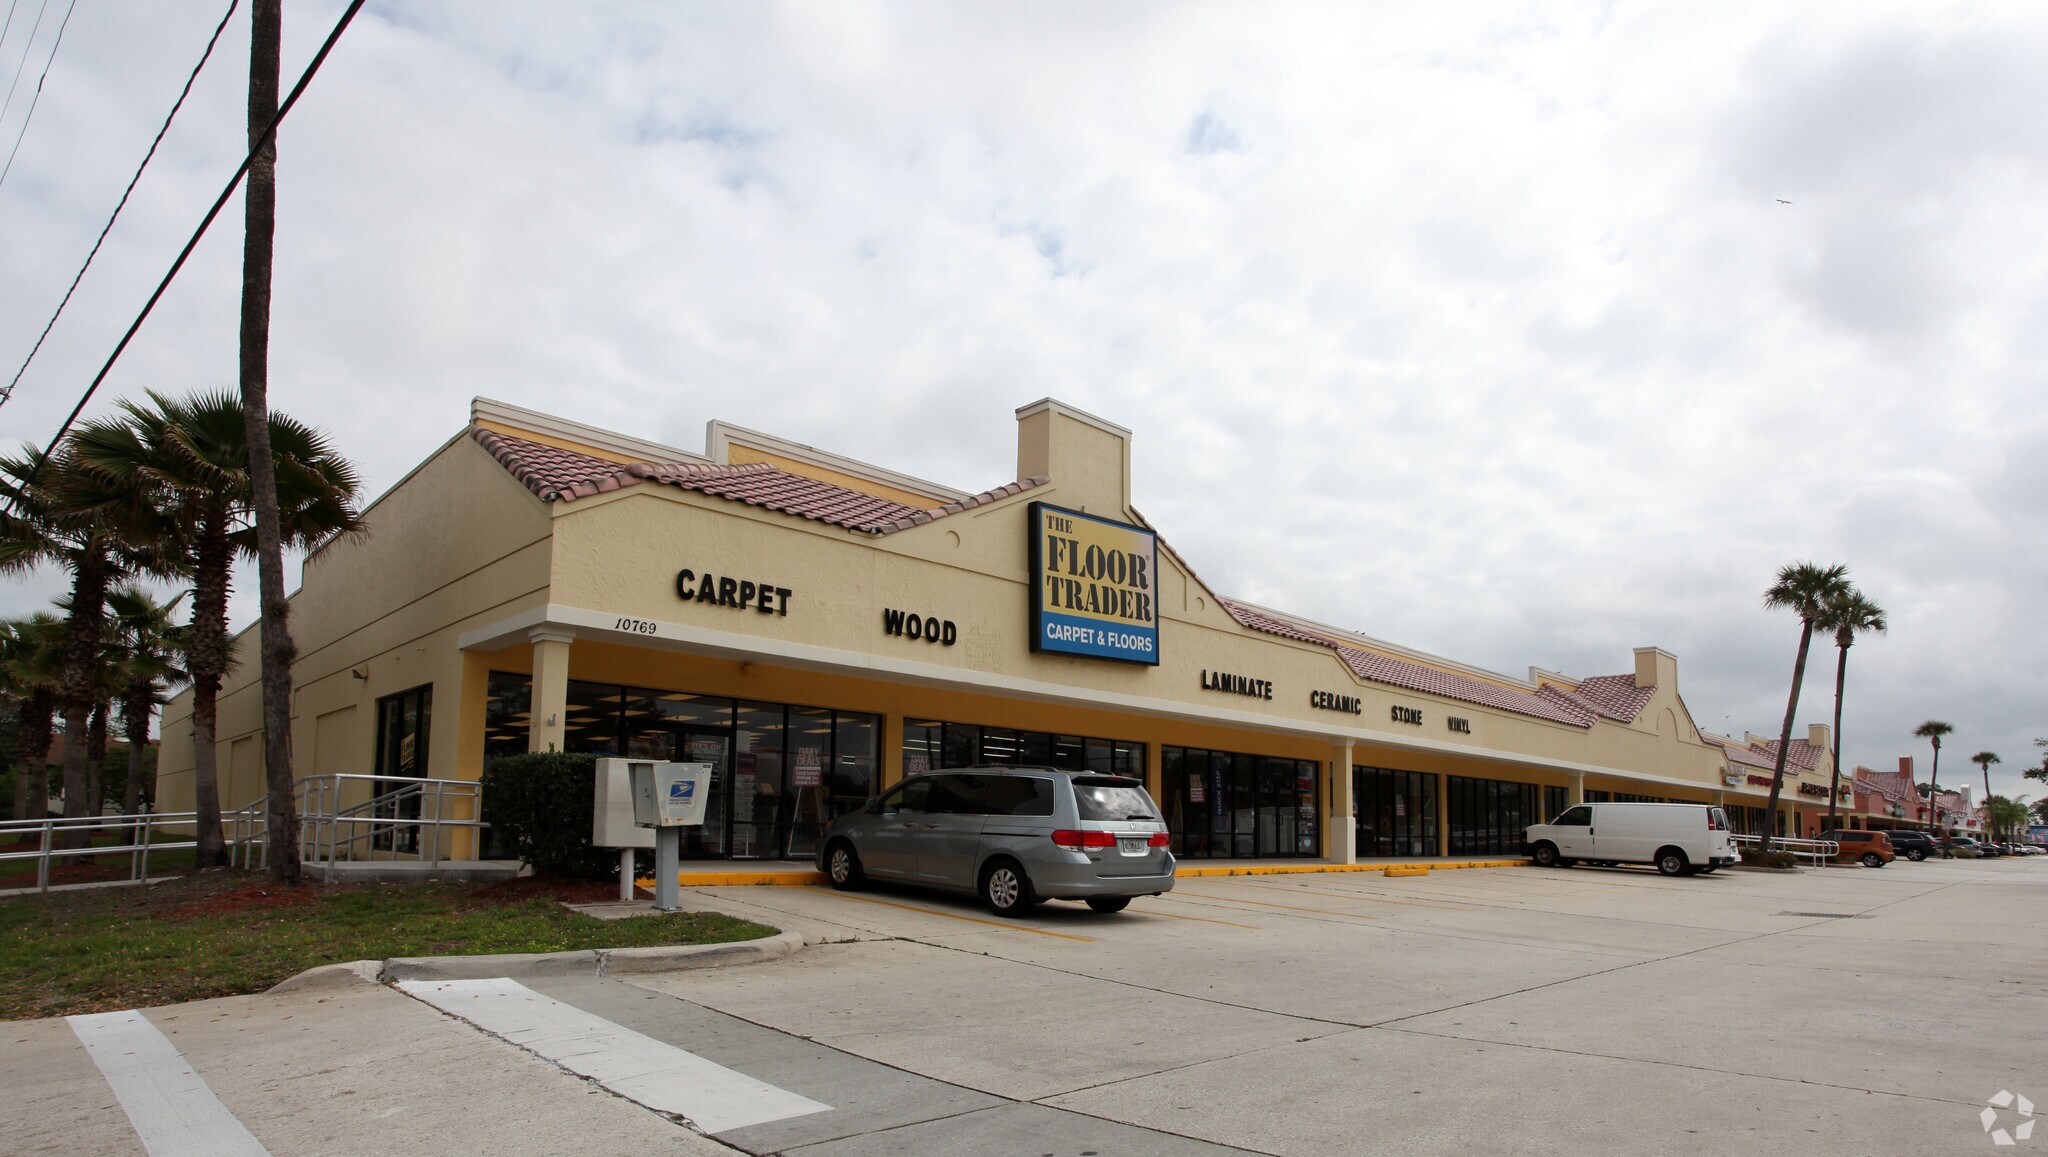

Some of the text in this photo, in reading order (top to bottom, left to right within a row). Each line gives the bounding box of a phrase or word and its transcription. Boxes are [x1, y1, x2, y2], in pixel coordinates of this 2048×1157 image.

[1046, 514, 1073, 535] THE
[1047, 534, 1149, 590] FLOOR
[676, 568, 792, 617] CARPET
[1046, 575, 1152, 622] TRADER
[615, 618, 657, 635] 10769
[884, 607, 957, 646] WOOD
[1046, 622, 1153, 652] CARPET & FLOORS
[1201, 669, 1273, 700] LAMINATE
[1310, 690, 1362, 715] CERAMIC
[1391, 705, 1423, 726] STONE
[1447, 715, 1471, 734] VINYL
[796, 756, 821, 766] DEALS
